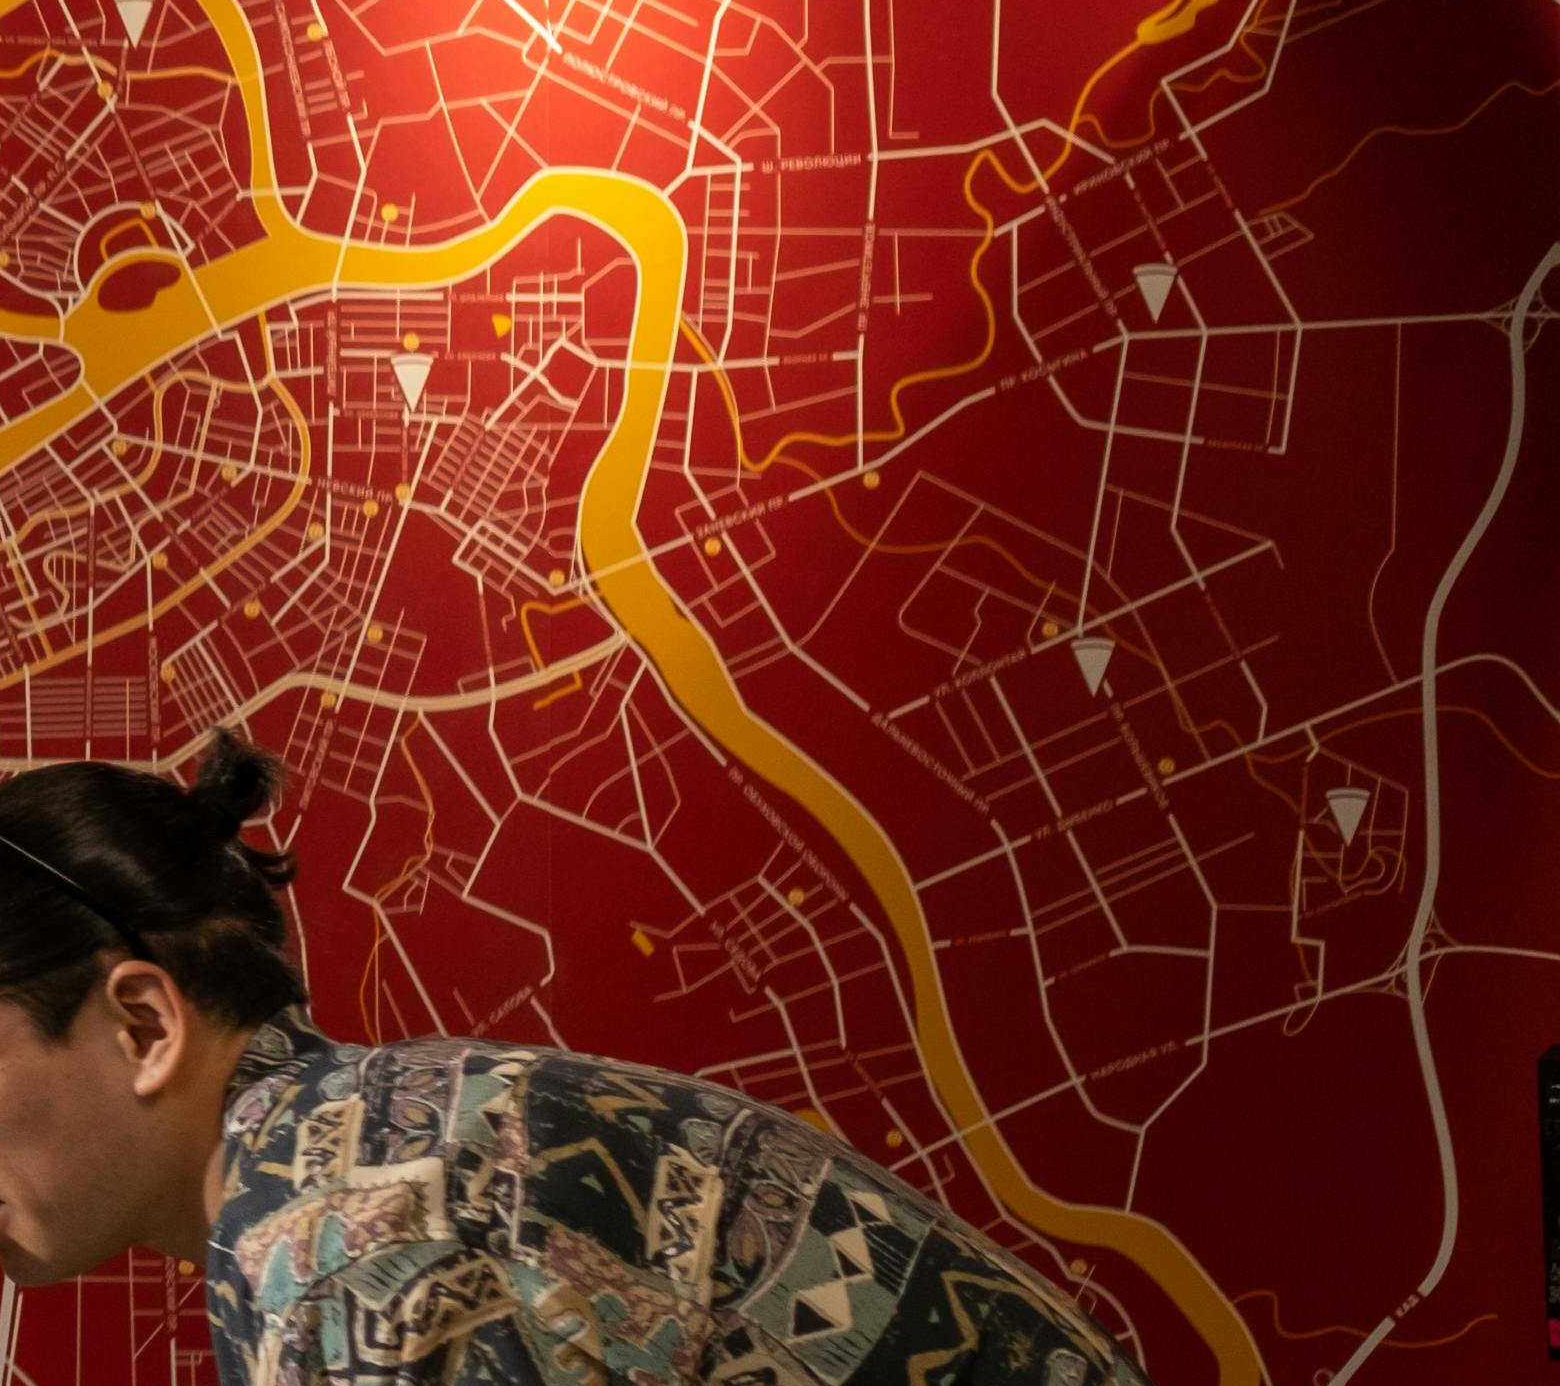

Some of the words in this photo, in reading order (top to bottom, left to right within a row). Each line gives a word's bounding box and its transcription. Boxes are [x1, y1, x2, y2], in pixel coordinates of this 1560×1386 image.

[779, 151, 862, 172] РЕВОЛЮЦИИ
[1019, 346, 1090, 384] КОСЫГИНА
[315, 473, 375, 502] НЕВСКИЙ
[693, 500, 768, 540] ЗАНЕВСКИЙ
